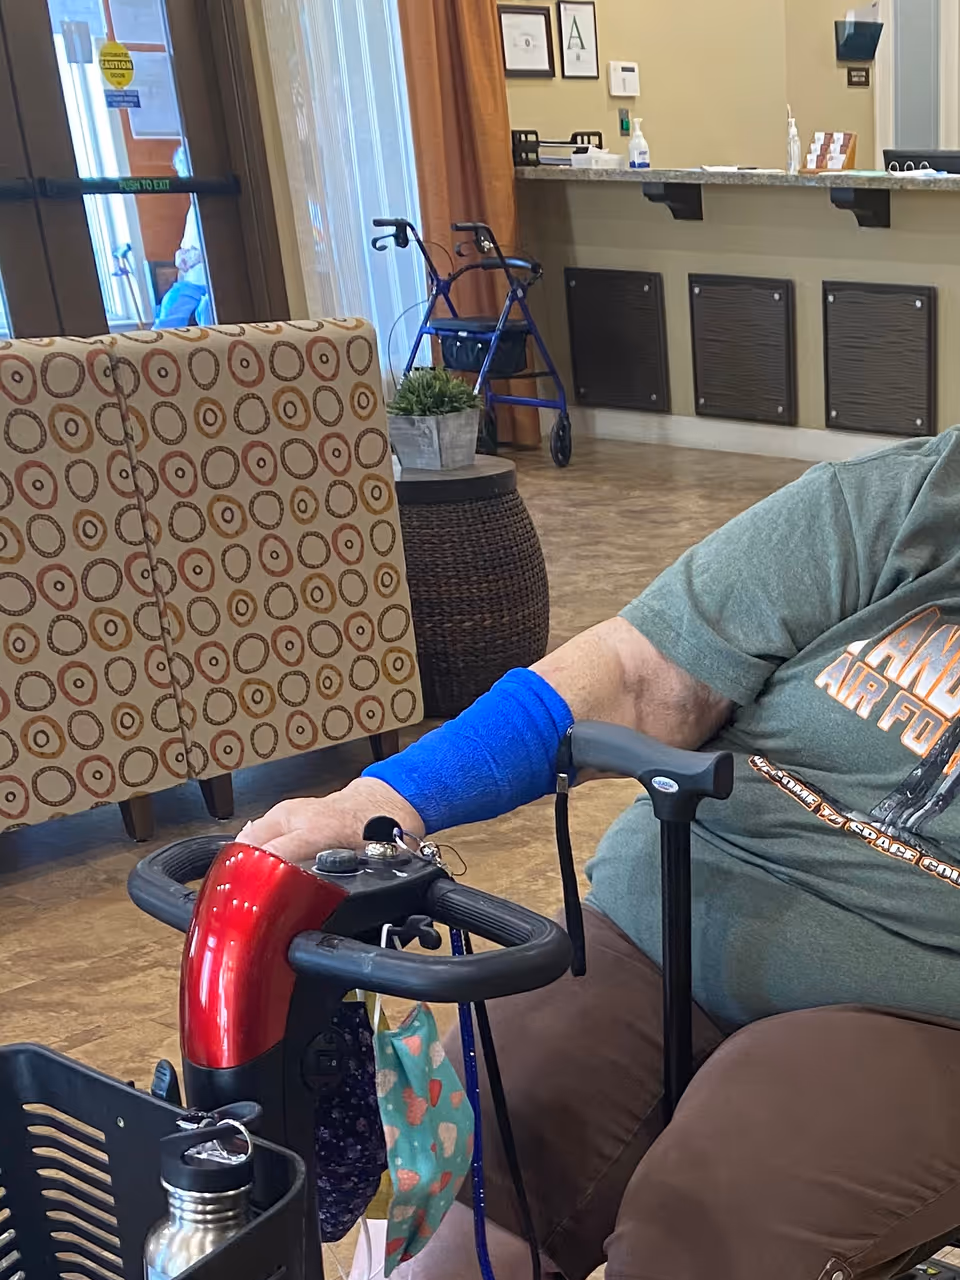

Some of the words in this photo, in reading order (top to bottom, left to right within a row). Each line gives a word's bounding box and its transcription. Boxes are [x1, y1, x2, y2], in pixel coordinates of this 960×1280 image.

[101, 60, 132, 69] CAUTION
[119, 180, 140, 191] PUSH
[140, 180, 152, 190] TO
[153, 179, 170, 190] EXIT
[815, 652, 889, 720] AIR
[749, 754, 821, 811] WECOME
[846, 821, 920, 865] SPACE
